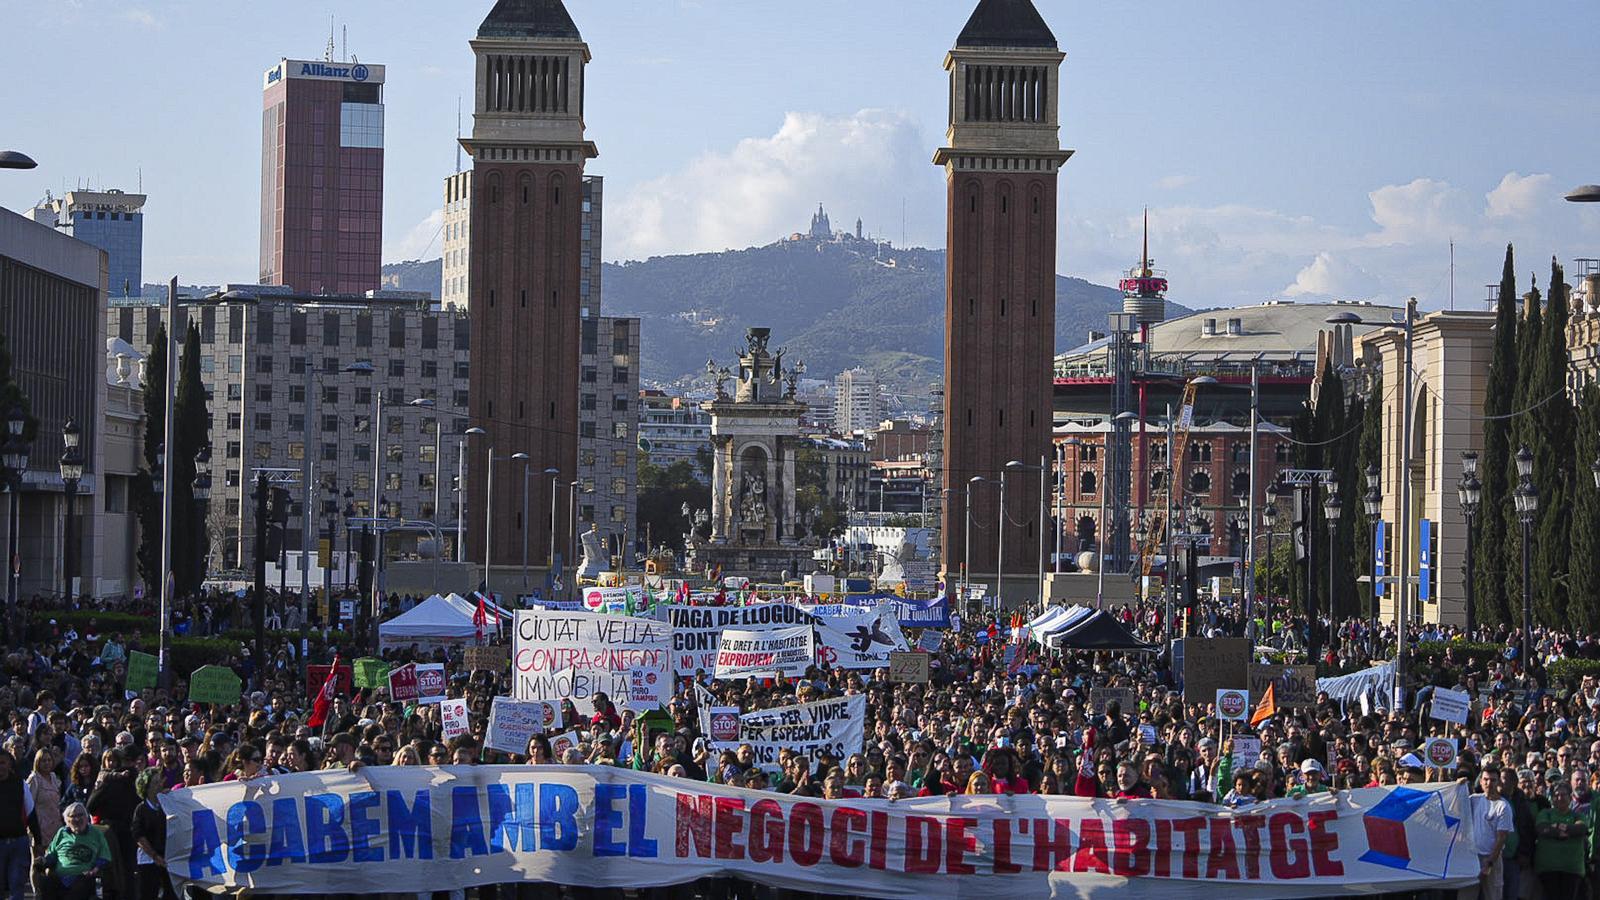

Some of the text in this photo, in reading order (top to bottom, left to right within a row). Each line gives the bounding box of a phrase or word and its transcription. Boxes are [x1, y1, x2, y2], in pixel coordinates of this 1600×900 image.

[301, 63, 350, 78] Allianz
[668, 608, 713, 628] VAGA
[717, 608, 738, 626] DE
[912, 606, 943, 622] QUALITAT
[597, 619, 660, 645] VELLA
[721, 638, 732, 650] PEL
[733, 639, 753, 652] DRET
[753, 640, 760, 651] A
[761, 635, 808, 652] L'HABITATGE
[516, 648, 592, 672] CONTRA
[680, 655, 694, 669] NO
[718, 652, 774, 667] EXPROPIEM
[632, 670, 643, 678] NO
[420, 676, 442, 687] STOP
[632, 678, 643, 687] ME
[632, 687, 649, 696] PIRO
[443, 704, 452, 713] NO
[1223, 697, 1242, 706] STOP
[444, 713, 454, 721] ME
[780, 708, 803, 725] PER
[444, 721, 460, 730] PIRO
[713, 720, 736, 730] STOP
[740, 723, 832, 742] PER ESPECULAR
[1432, 746, 1451, 754] STOP
[188, 783, 1345, 880] ACABEM AMB EL NEGOCI DE L'HABITATGE
